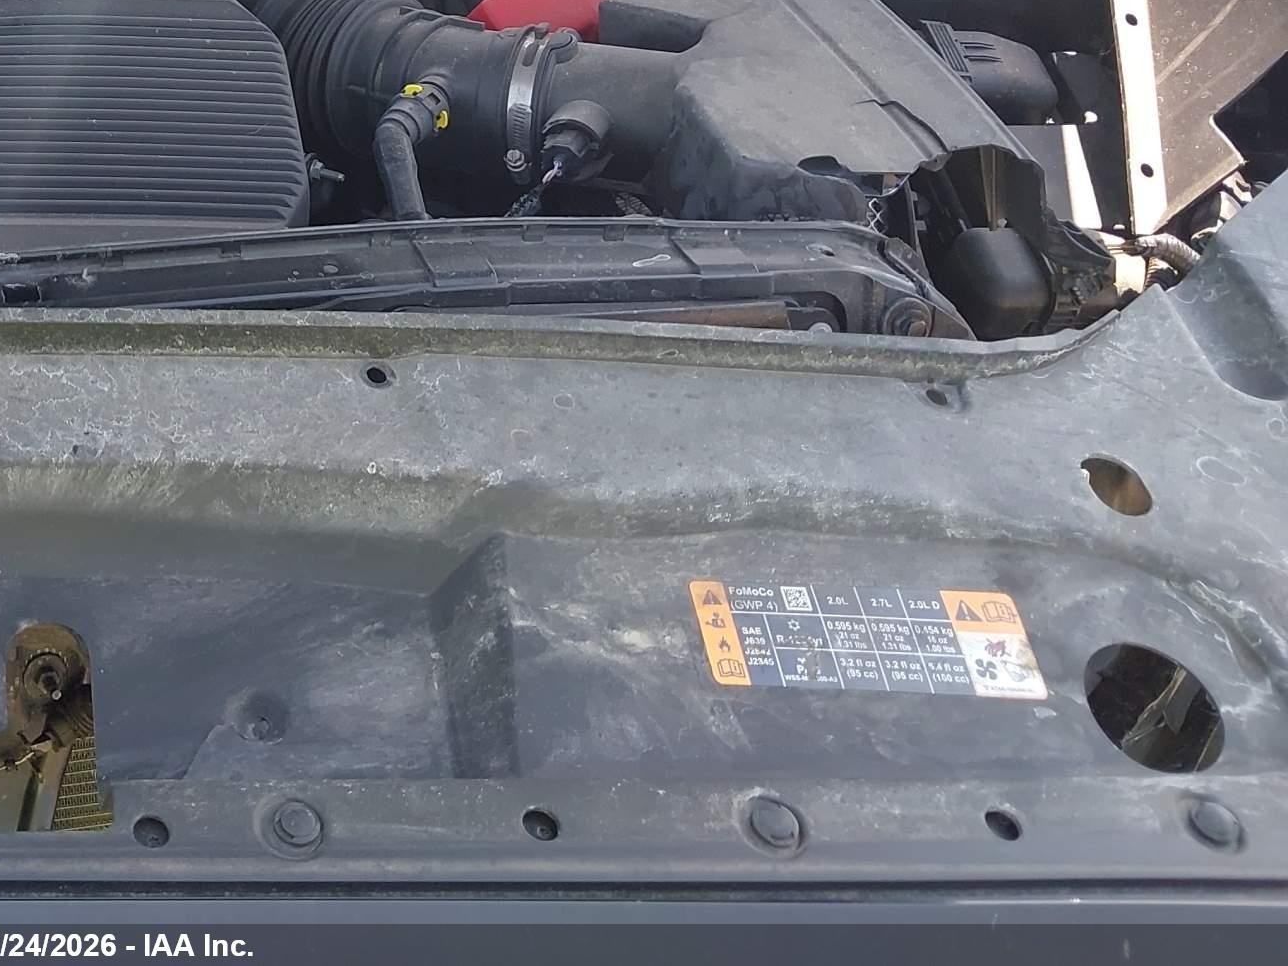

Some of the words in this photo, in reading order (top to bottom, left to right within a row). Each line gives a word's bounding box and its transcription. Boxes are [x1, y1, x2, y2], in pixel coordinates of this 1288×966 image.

[728, 586, 774, 597] FoMoCo
[826, 596, 848, 605] 2.0L
[870, 598, 892, 608] 2.7L
[908, 600, 930, 609] 2.0L
[932, 601, 940, 610] D
[730, 600, 763, 611] (GWP
[766, 602, 778, 612] 4)
[742, 626, 763, 635] SAE
[854, 622, 866, 633] kg
[897, 624, 910, 635] kg
[941, 627, 954, 637] kg
[840, 658, 854, 667] 3.2
[865, 660, 877, 668] oz
[885, 660, 899, 669] 3.2
[909, 662, 922, 670] oz
[864, 670, 878, 681] cc)
[909, 672, 924, 683] cc)
[955, 674, 970, 685] cc)
